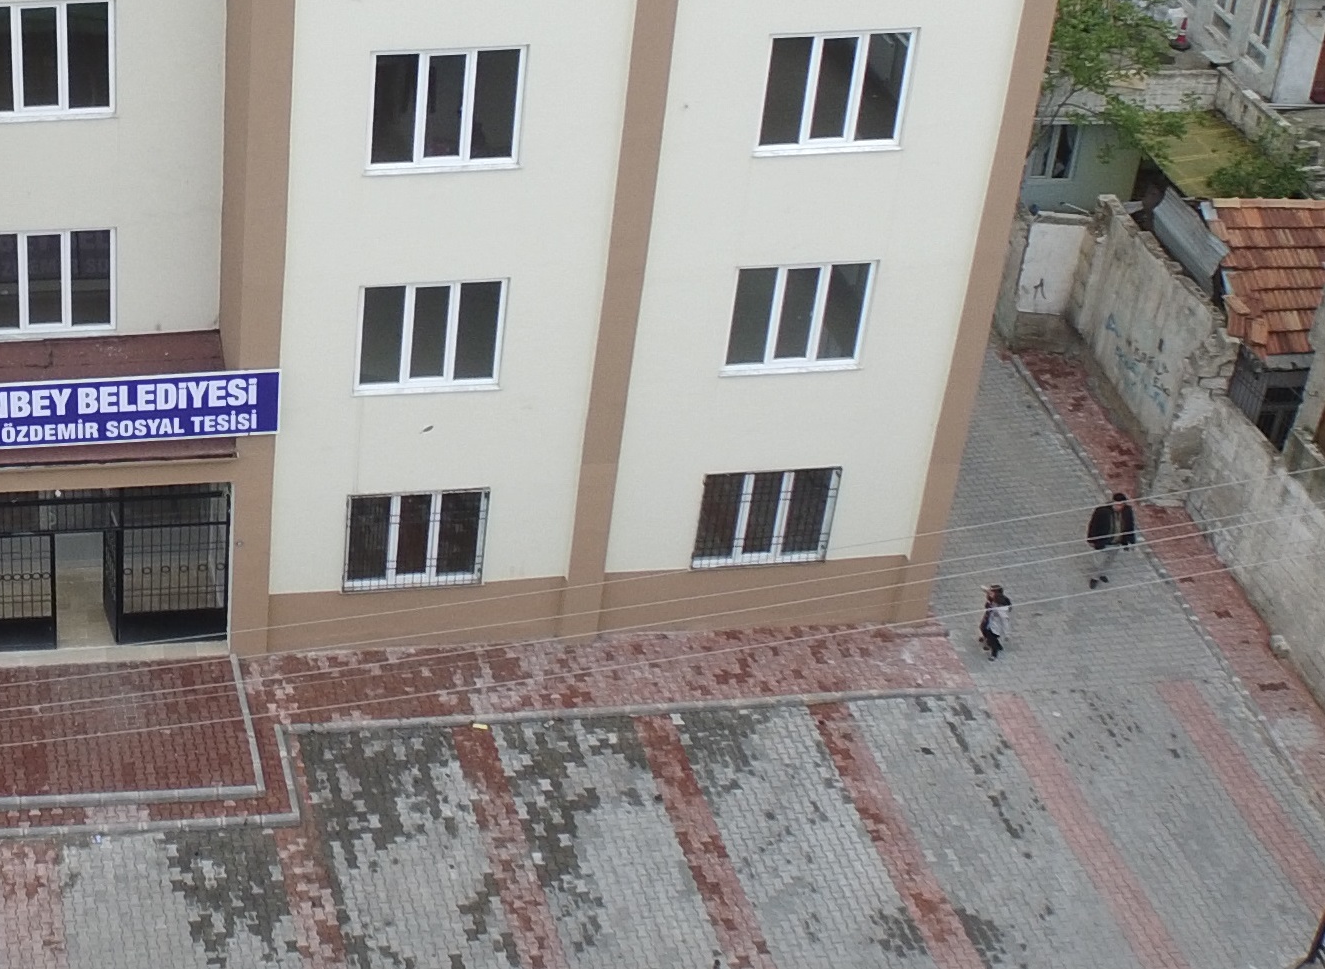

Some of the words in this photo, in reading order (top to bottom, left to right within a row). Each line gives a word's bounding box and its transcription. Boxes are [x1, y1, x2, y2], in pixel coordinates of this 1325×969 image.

[77, 378, 258, 415] BELEDİYESİ
[1, 419, 99, 443] ÖZDEMİR
[105, 417, 185, 439] SOSYAL
[191, 409, 258, 432] TESİSİ
